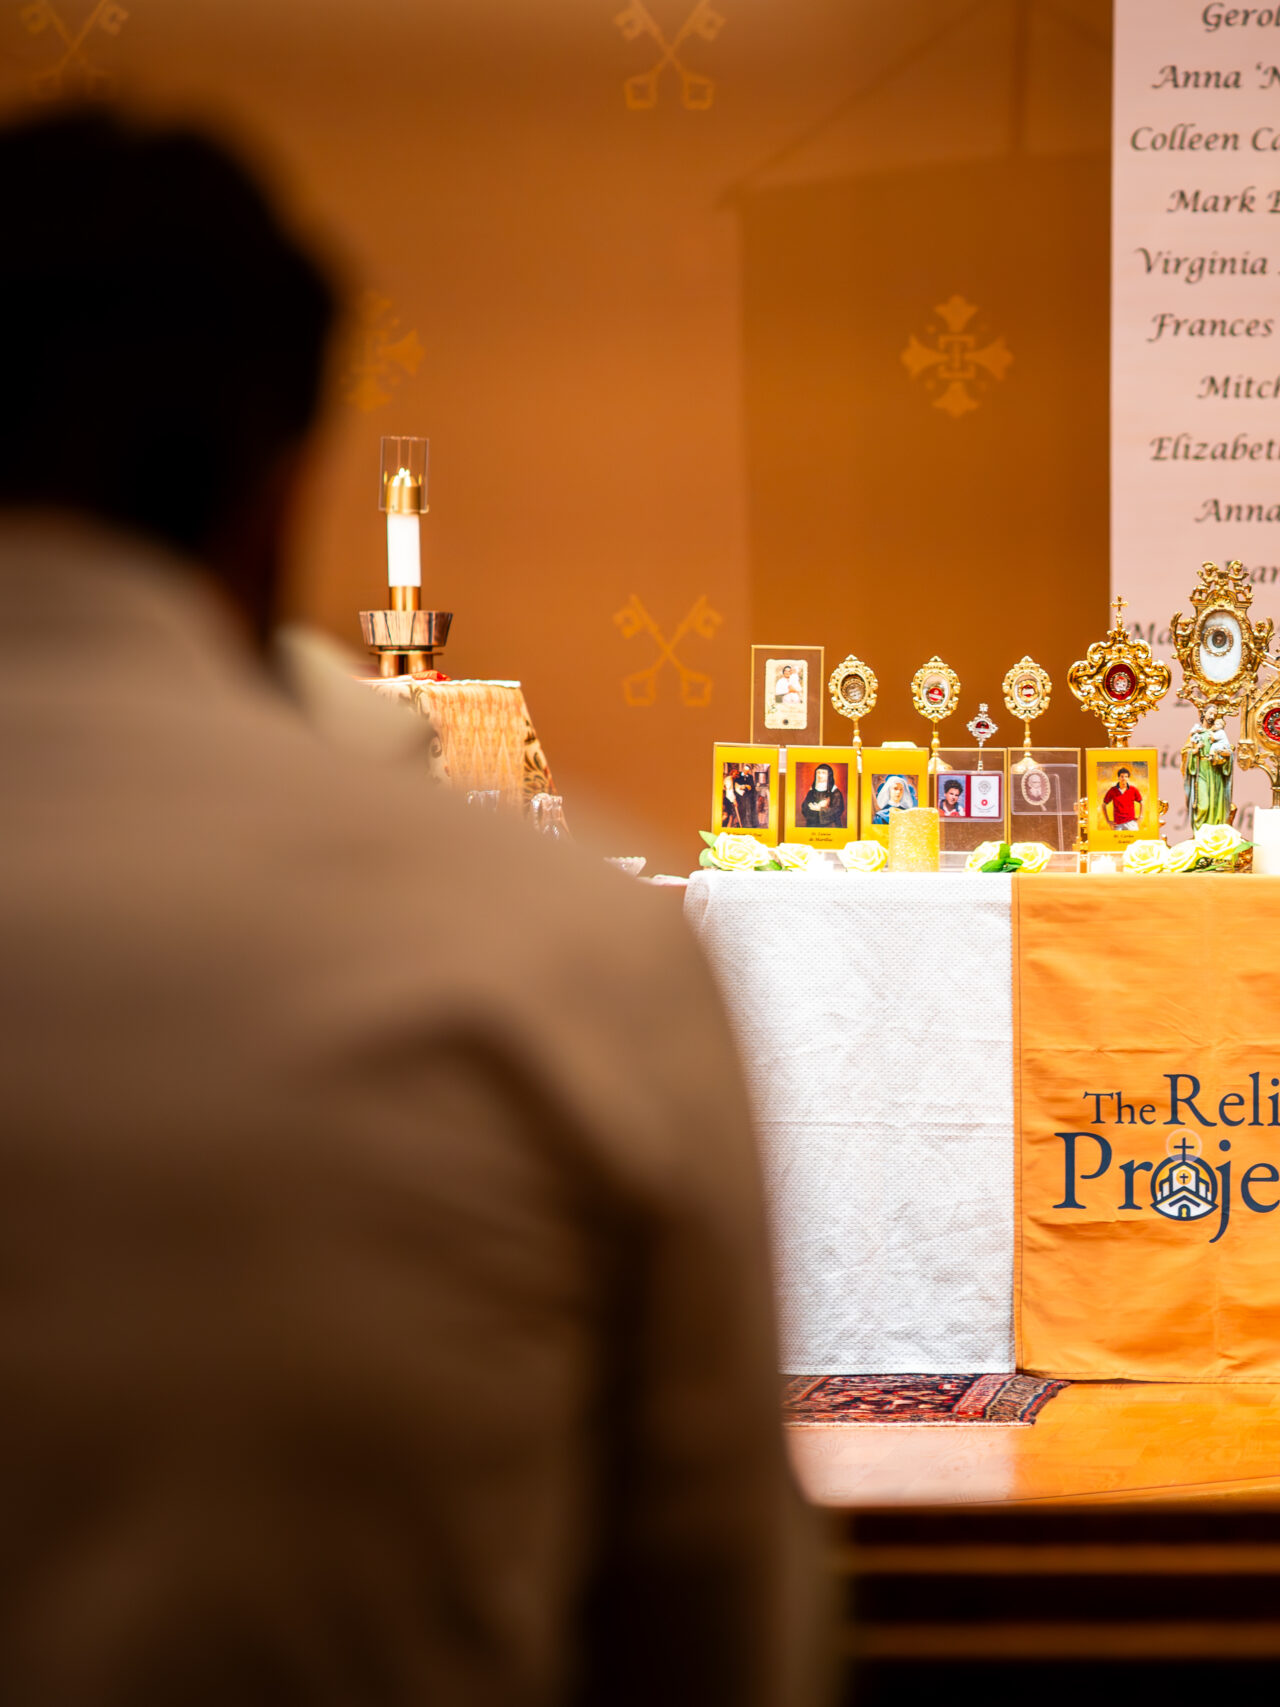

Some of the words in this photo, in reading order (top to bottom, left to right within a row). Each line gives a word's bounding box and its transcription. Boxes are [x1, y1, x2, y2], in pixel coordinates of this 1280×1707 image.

[1151, 64, 1242, 90] Anna
[1129, 123, 1240, 152] Colleen
[1166, 186, 1257, 214] Mark
[1134, 247, 1269, 284] Virginia
[1146, 312, 1275, 343] Frances
[1082, 1090, 1157, 1126] The
